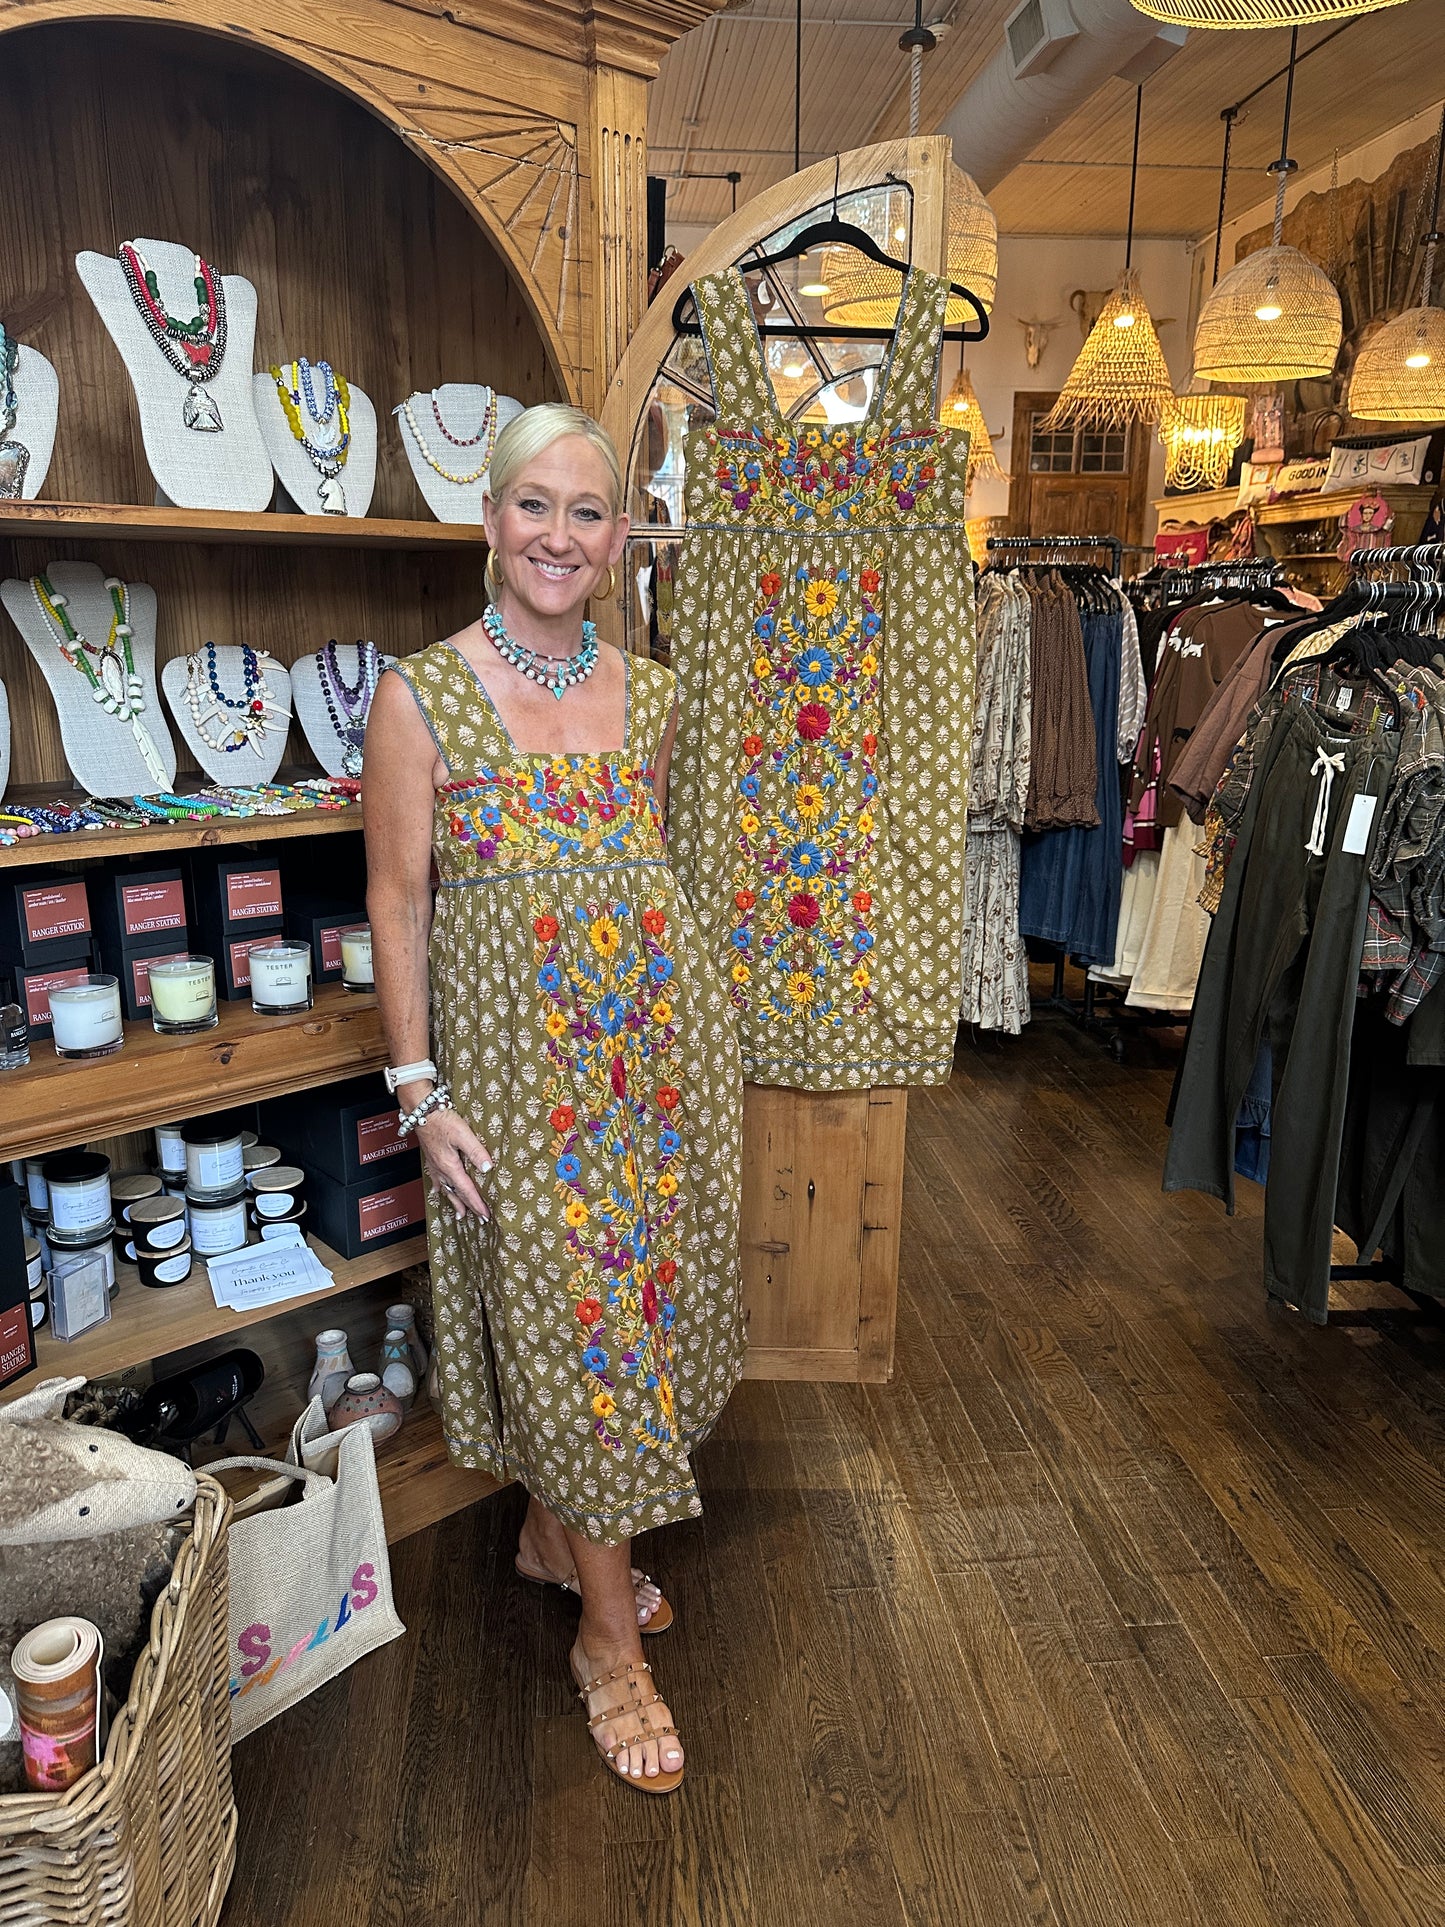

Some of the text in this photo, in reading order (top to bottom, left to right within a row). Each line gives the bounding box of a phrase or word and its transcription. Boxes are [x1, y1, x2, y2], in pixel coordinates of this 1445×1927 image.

[1288, 469, 1315, 481] GOOD
[232, 907, 256, 917] RANGER
[256, 904, 279, 914] STATION
[31, 926, 59, 938] RANGER
[59, 921, 85, 933] STATION
[129, 919, 155, 932] RANGER
[155, 916, 181, 928] STATION
[266, 963, 293, 971] TESTER
[325, 960, 342, 968] RANG
[139, 995, 152, 1004] RAN
[32, 1011, 52, 1022] RANG
[362, 1148, 386, 1162] RANGER
[385, 1141, 408, 1155] STATION
[363, 1225, 387, 1239] RANGER
[386, 1216, 409, 1231] STATION
[231, 1269, 296, 1287] Thank you
[0, 1343, 26, 1364] RANGER
[1, 1351, 26, 1373] STATION
